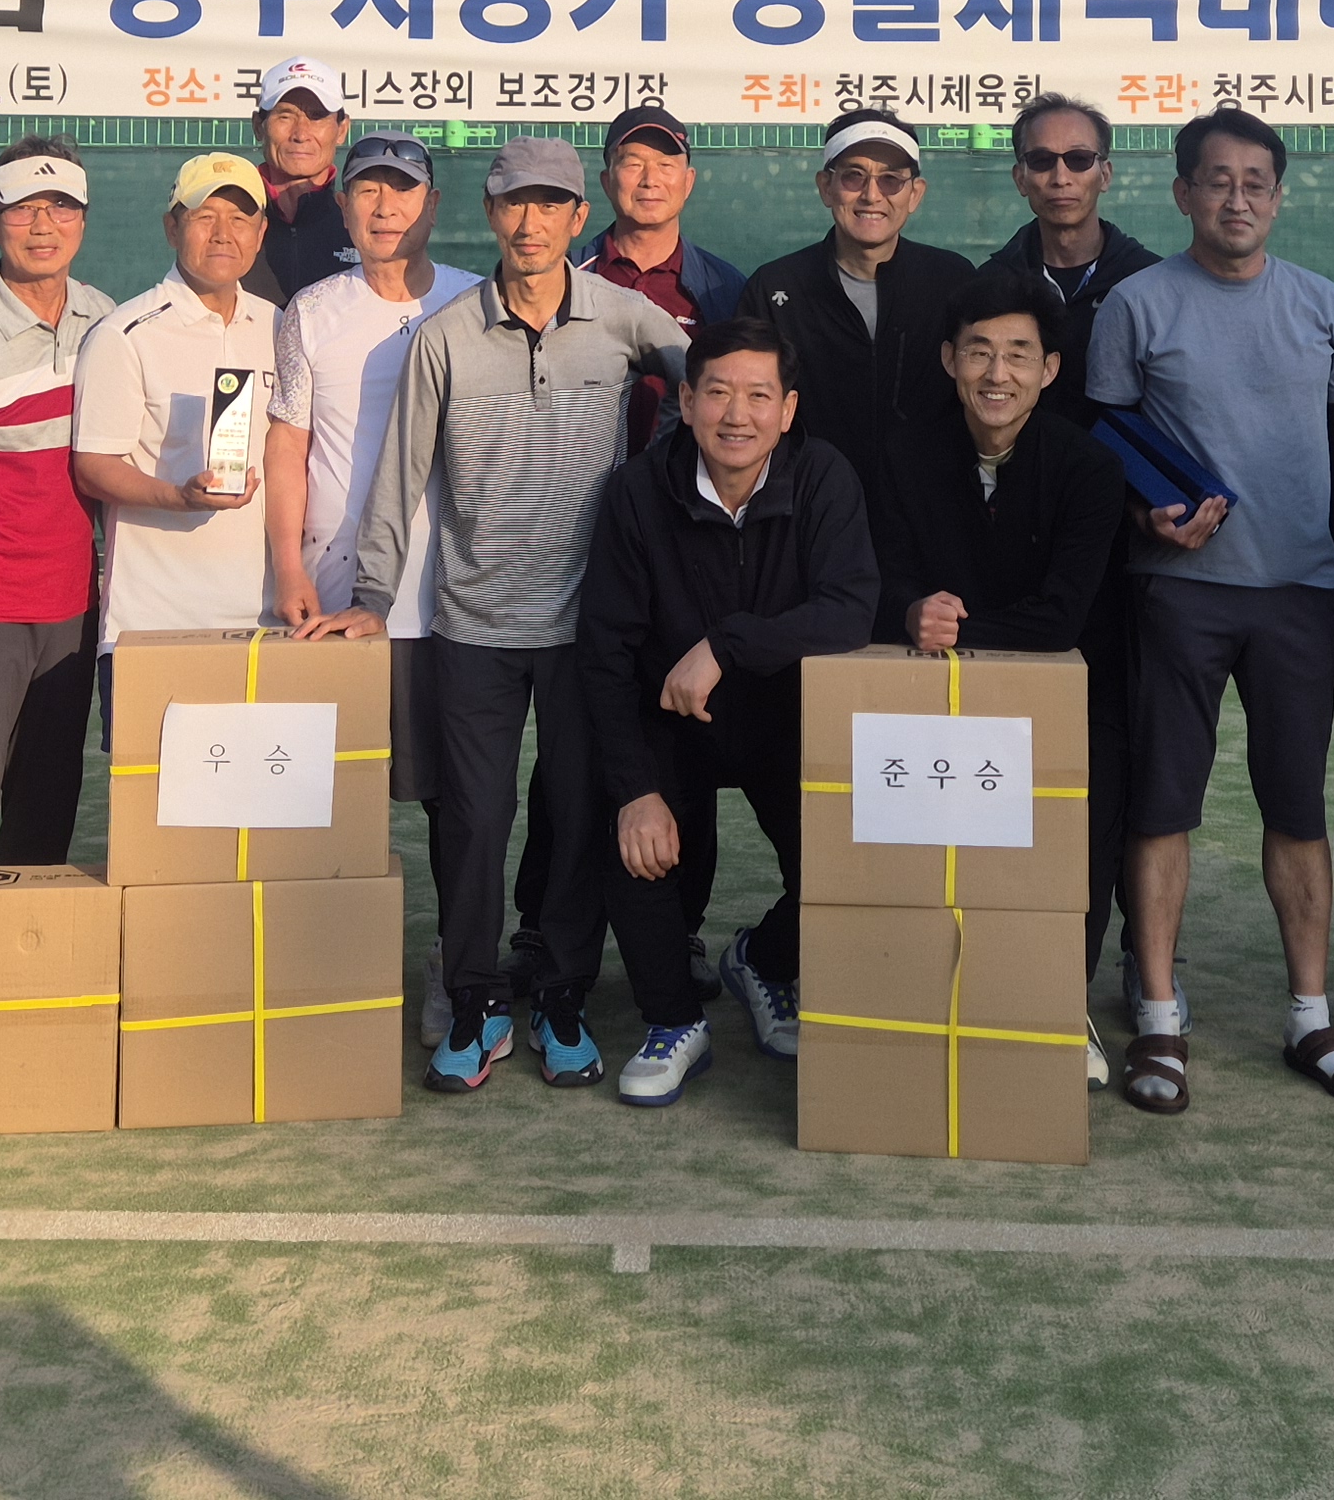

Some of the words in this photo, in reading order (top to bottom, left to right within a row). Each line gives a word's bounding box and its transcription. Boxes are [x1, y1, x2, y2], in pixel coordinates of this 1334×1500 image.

[141, 67, 221, 108] 장소:
[233, 69, 474, 112] 국니스장외
[497, 71, 669, 111] 보조경기장
[741, 73, 821, 113] 주최:
[834, 73, 1041, 113] 청주시체육회
[1117, 73, 1199, 114] 주관:
